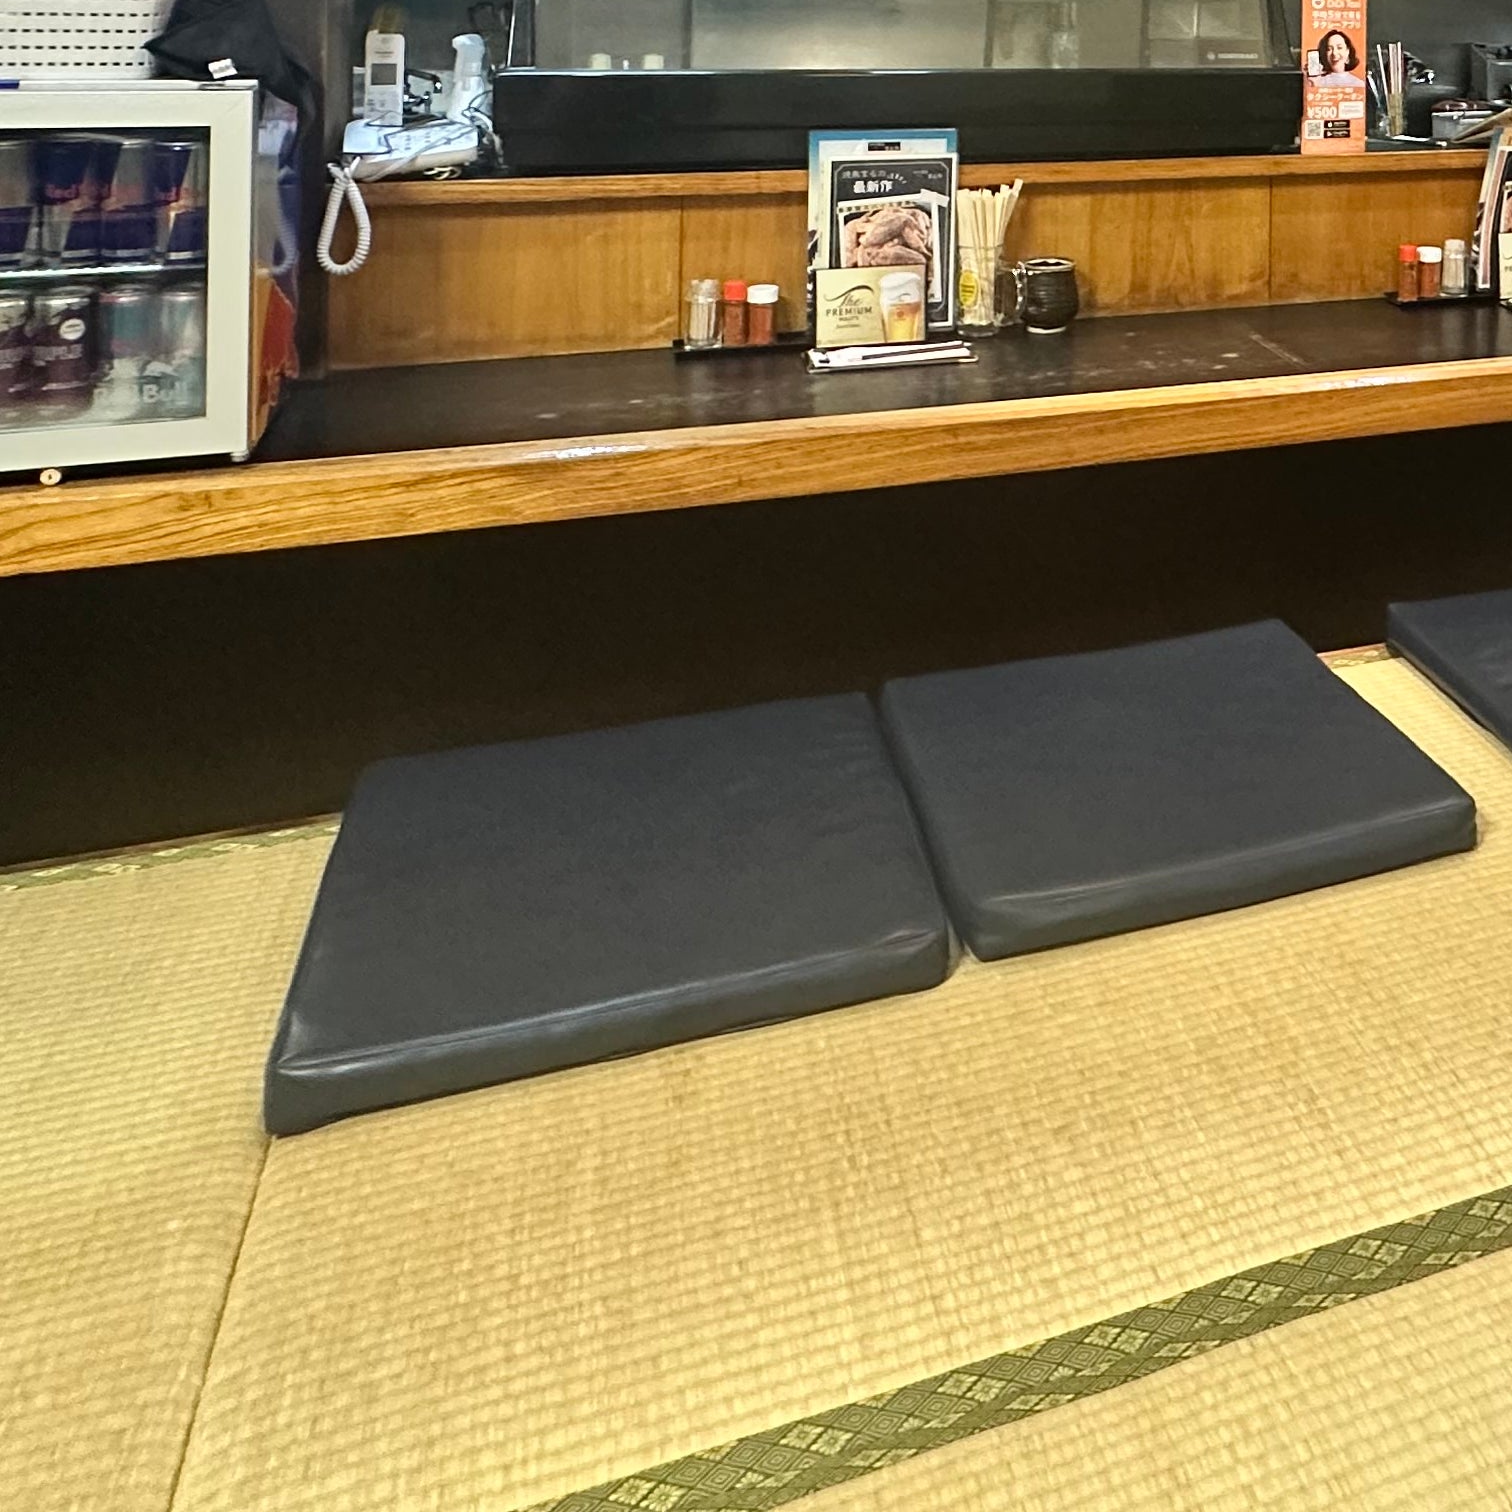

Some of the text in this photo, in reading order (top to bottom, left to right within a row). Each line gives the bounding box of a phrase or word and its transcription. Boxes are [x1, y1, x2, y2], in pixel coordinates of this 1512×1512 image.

[853, 180, 894, 193] 最新作
[826, 306, 873, 317] PREMIUM
